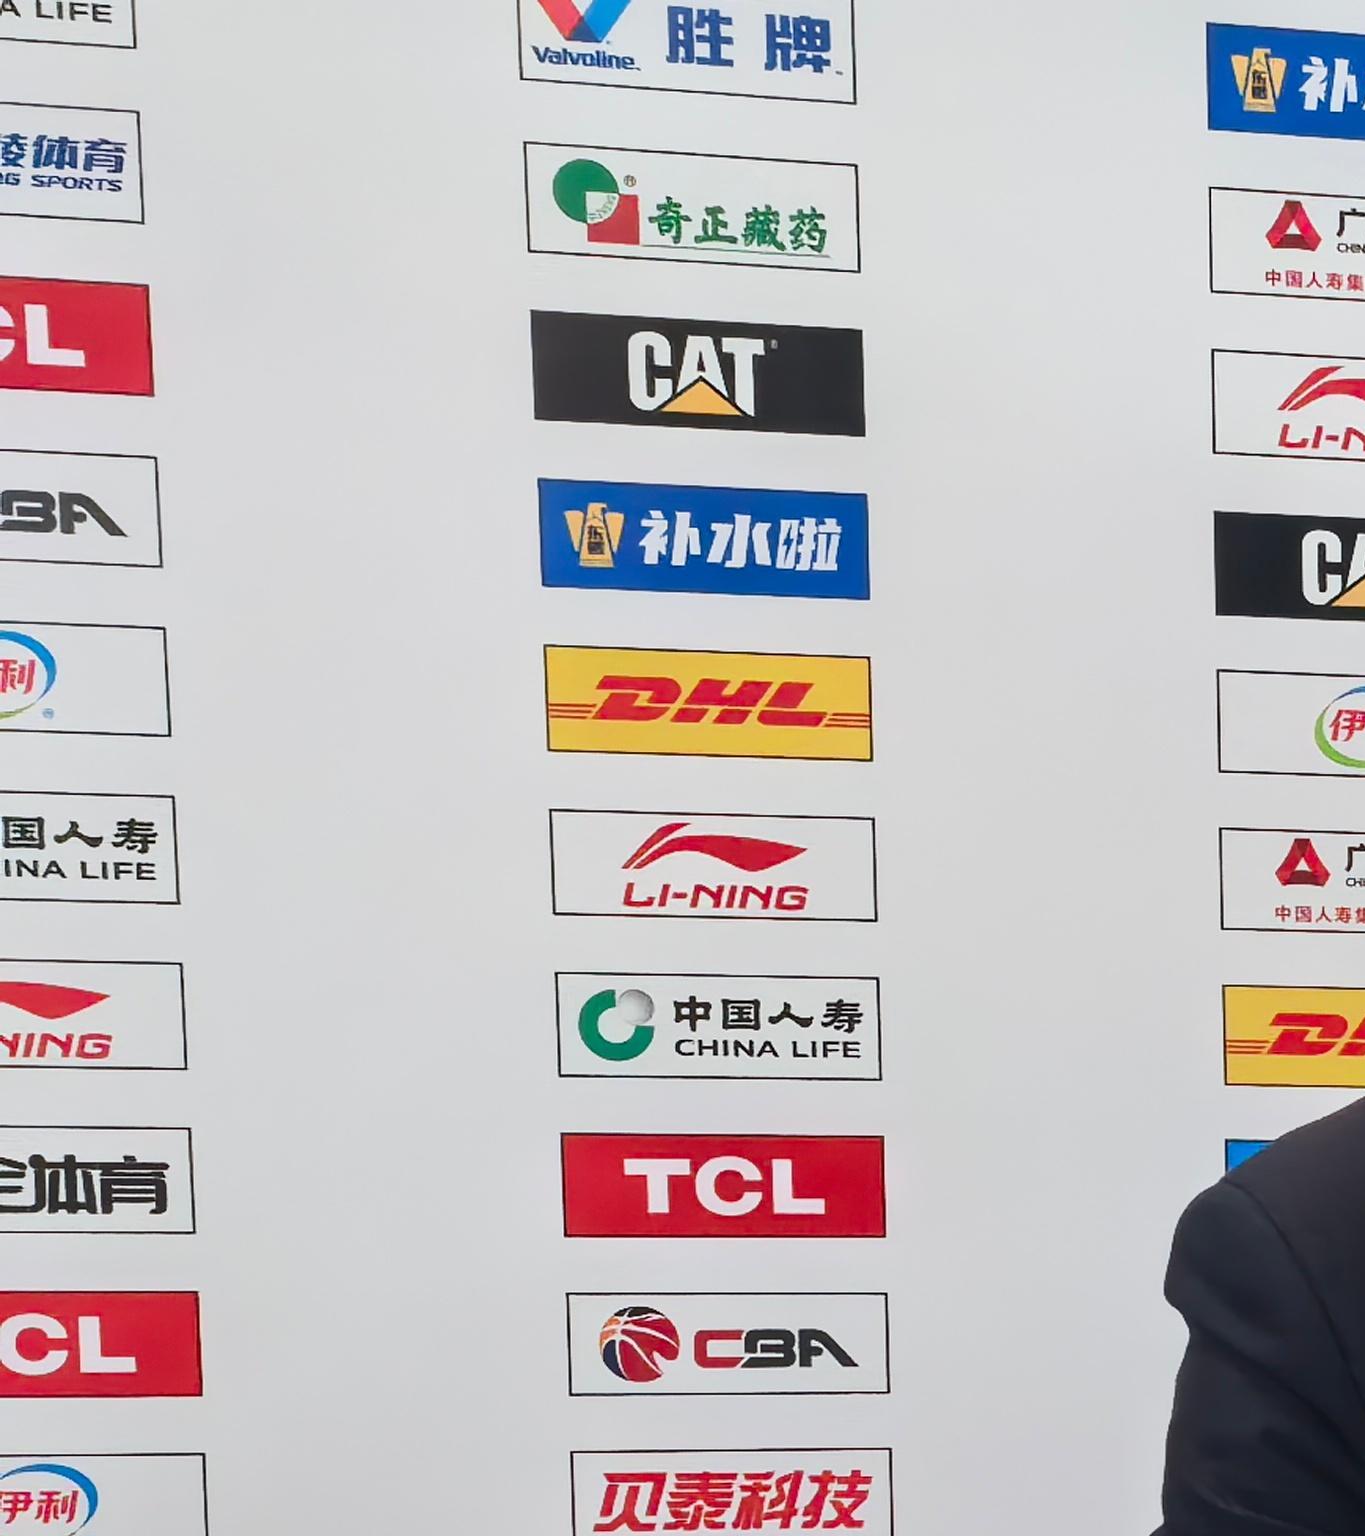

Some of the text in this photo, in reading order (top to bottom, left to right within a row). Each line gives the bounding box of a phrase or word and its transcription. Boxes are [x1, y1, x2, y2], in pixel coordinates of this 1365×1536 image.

[36, 0, 112, 23] LIFE
[532, 46, 637, 71] Valvoline
[666, 6, 831, 73] 胜牌
[31, 175, 122, 192] SPORTS
[648, 196, 828, 253] 奇正藏药
[628, 331, 765, 416] CAT
[0, 490, 128, 537] BA
[639, 510, 842, 570] 补水啦
[0, 659, 35, 694] 利
[592, 675, 828, 727] DHL
[2, 816, 158, 854] 国人寿
[5, 859, 158, 881] INA LIFE
[623, 883, 809, 911] LI-NING
[674, 996, 863, 1033] 中国人寿
[0, 1033, 112, 1059] NING
[675, 1039, 861, 1058] CHINA LIFE
[624, 1156, 825, 1216] TCL
[0, 1313, 137, 1375] CL
[694, 1329, 859, 1368] CBA
[593, 1470, 872, 1532] 贝泰科技
